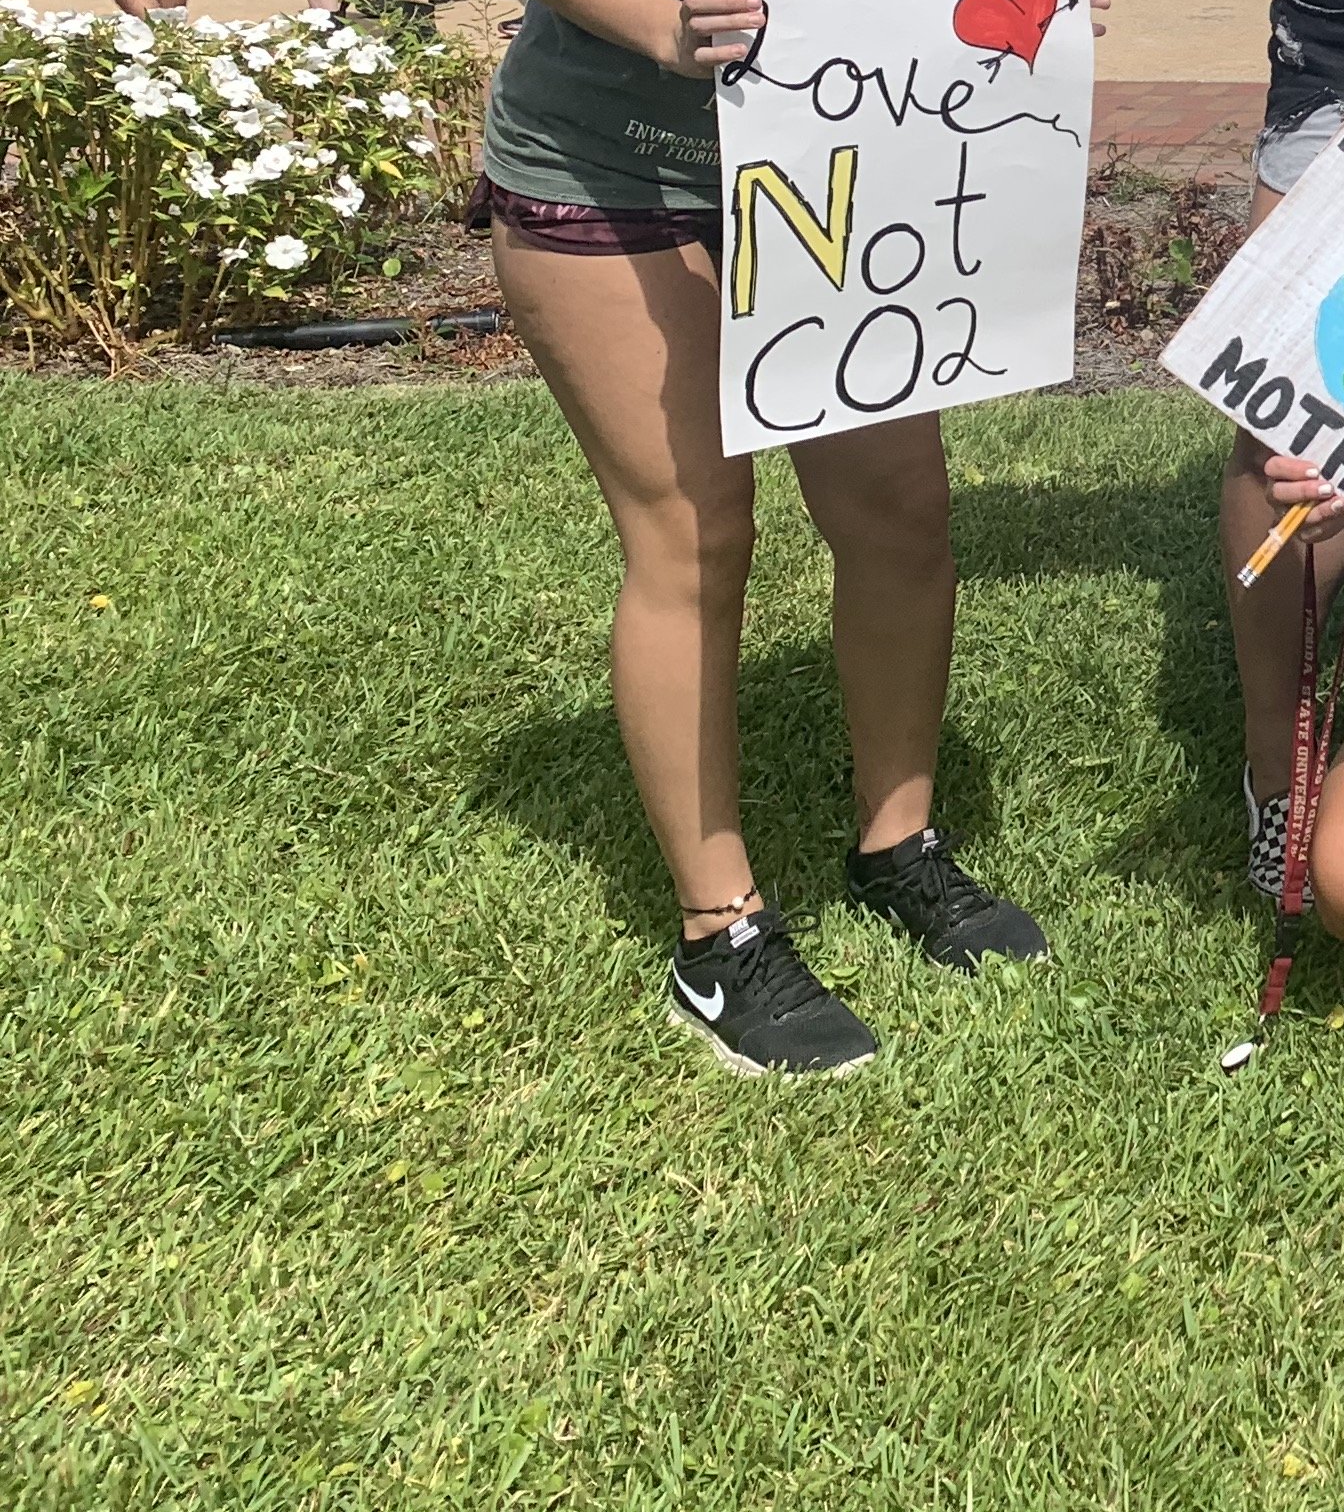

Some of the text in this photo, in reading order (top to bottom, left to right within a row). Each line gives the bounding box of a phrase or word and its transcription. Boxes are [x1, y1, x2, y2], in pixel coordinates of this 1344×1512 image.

[634, 142, 659, 156] AT
[731, 141, 985, 318] Not
[745, 296, 1007, 430] CO2
[1298, 685, 1311, 740] STATE
[1292, 746, 1308, 842] UNIVERSITY
